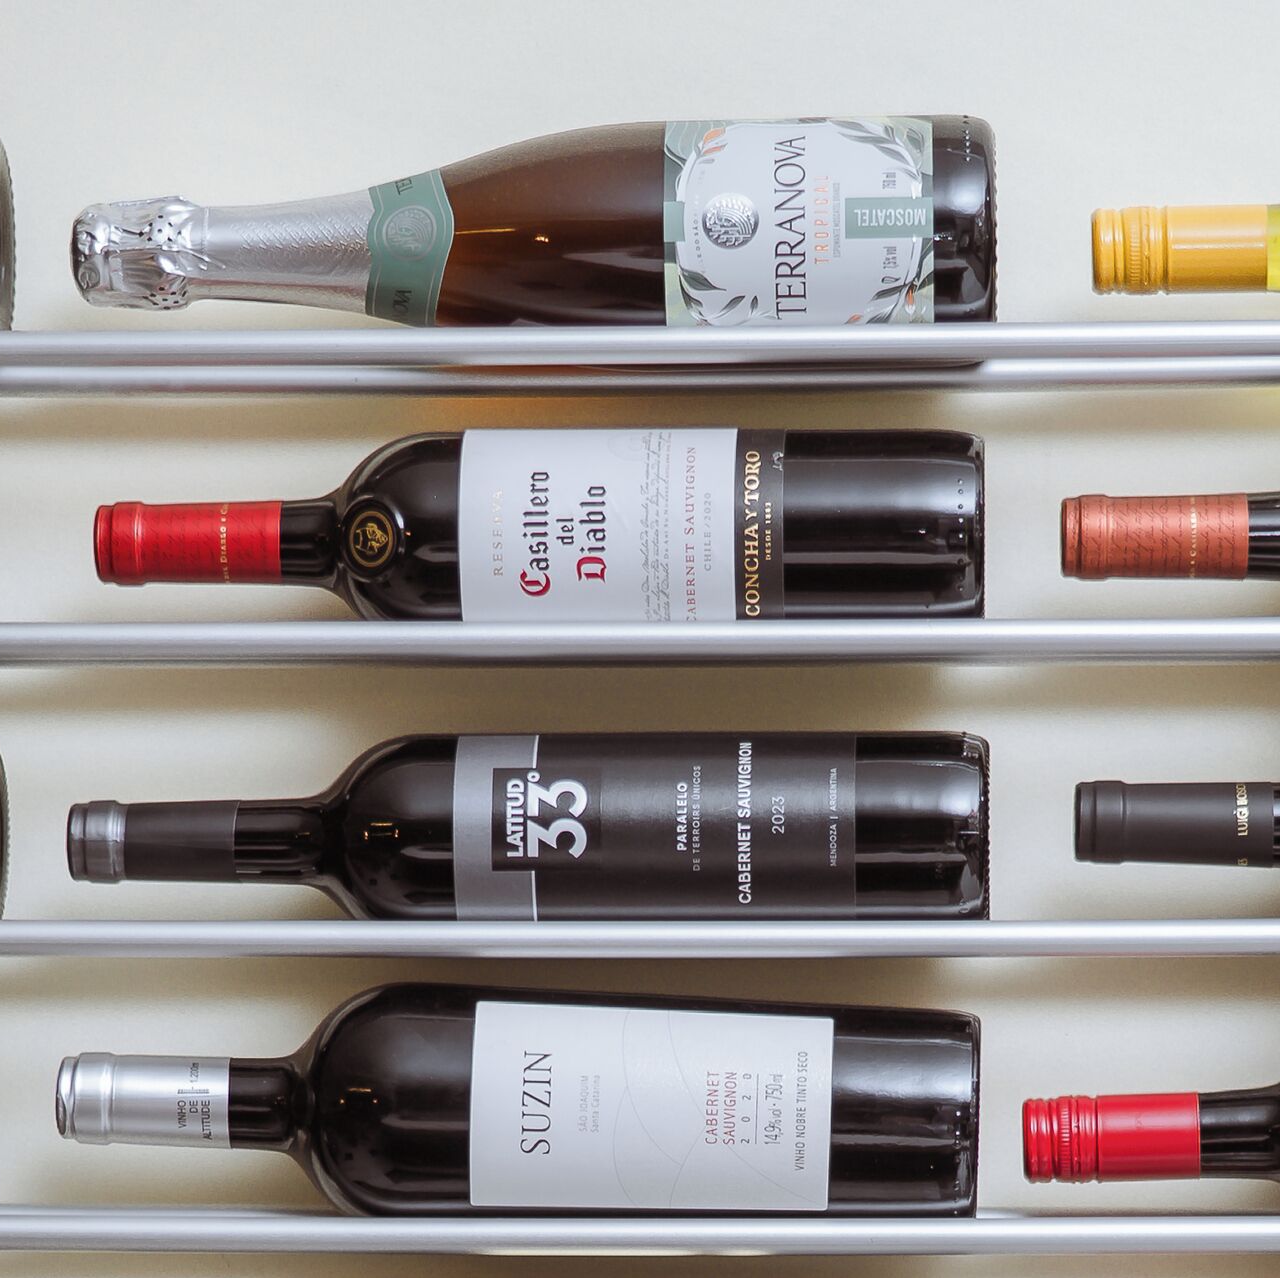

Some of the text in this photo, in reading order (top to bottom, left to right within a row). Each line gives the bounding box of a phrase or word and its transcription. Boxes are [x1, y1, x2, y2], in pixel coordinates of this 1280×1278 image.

[774, 135, 808, 320] TERRANOVA
[814, 174, 830, 264] TROPICAL
[854, 207, 926, 226] MOSCATEL
[492, 488, 504, 576] RESERVA
[556, 517, 575, 546] del
[684, 445, 697, 536] SAUVIGNON
[743, 449, 762, 616] CONCHA Y TORO
[518, 469, 552, 598] Casillero
[576, 485, 607, 583] Diablo
[506, 778, 524, 858] LATITUD
[675, 781, 688, 851] PARALELO
[690, 765, 702, 872] DE TERROIRS ÚNICOS
[736, 741, 753, 904] CABERNET SAUVIGNON
[771, 795, 786, 835] 2023
[828, 767, 838, 866] MENDOZA ARGENTINA
[176, 1099, 187, 1129] VINHO
[189, 1099, 199, 1114] DE
[201, 1099, 213, 1140] ALTITUDE
[520, 1049, 552, 1156] SUZIN
[578, 1074, 590, 1133] SÃO JOAQUIM
[590, 1073, 601, 1134] Santa Catarina
[704, 1070, 720, 1146] CABERNET
[722, 1071, 738, 1146] SAUVIGNON
[794, 1051, 810, 1172] VINHO NOBRE TINTO SECO
